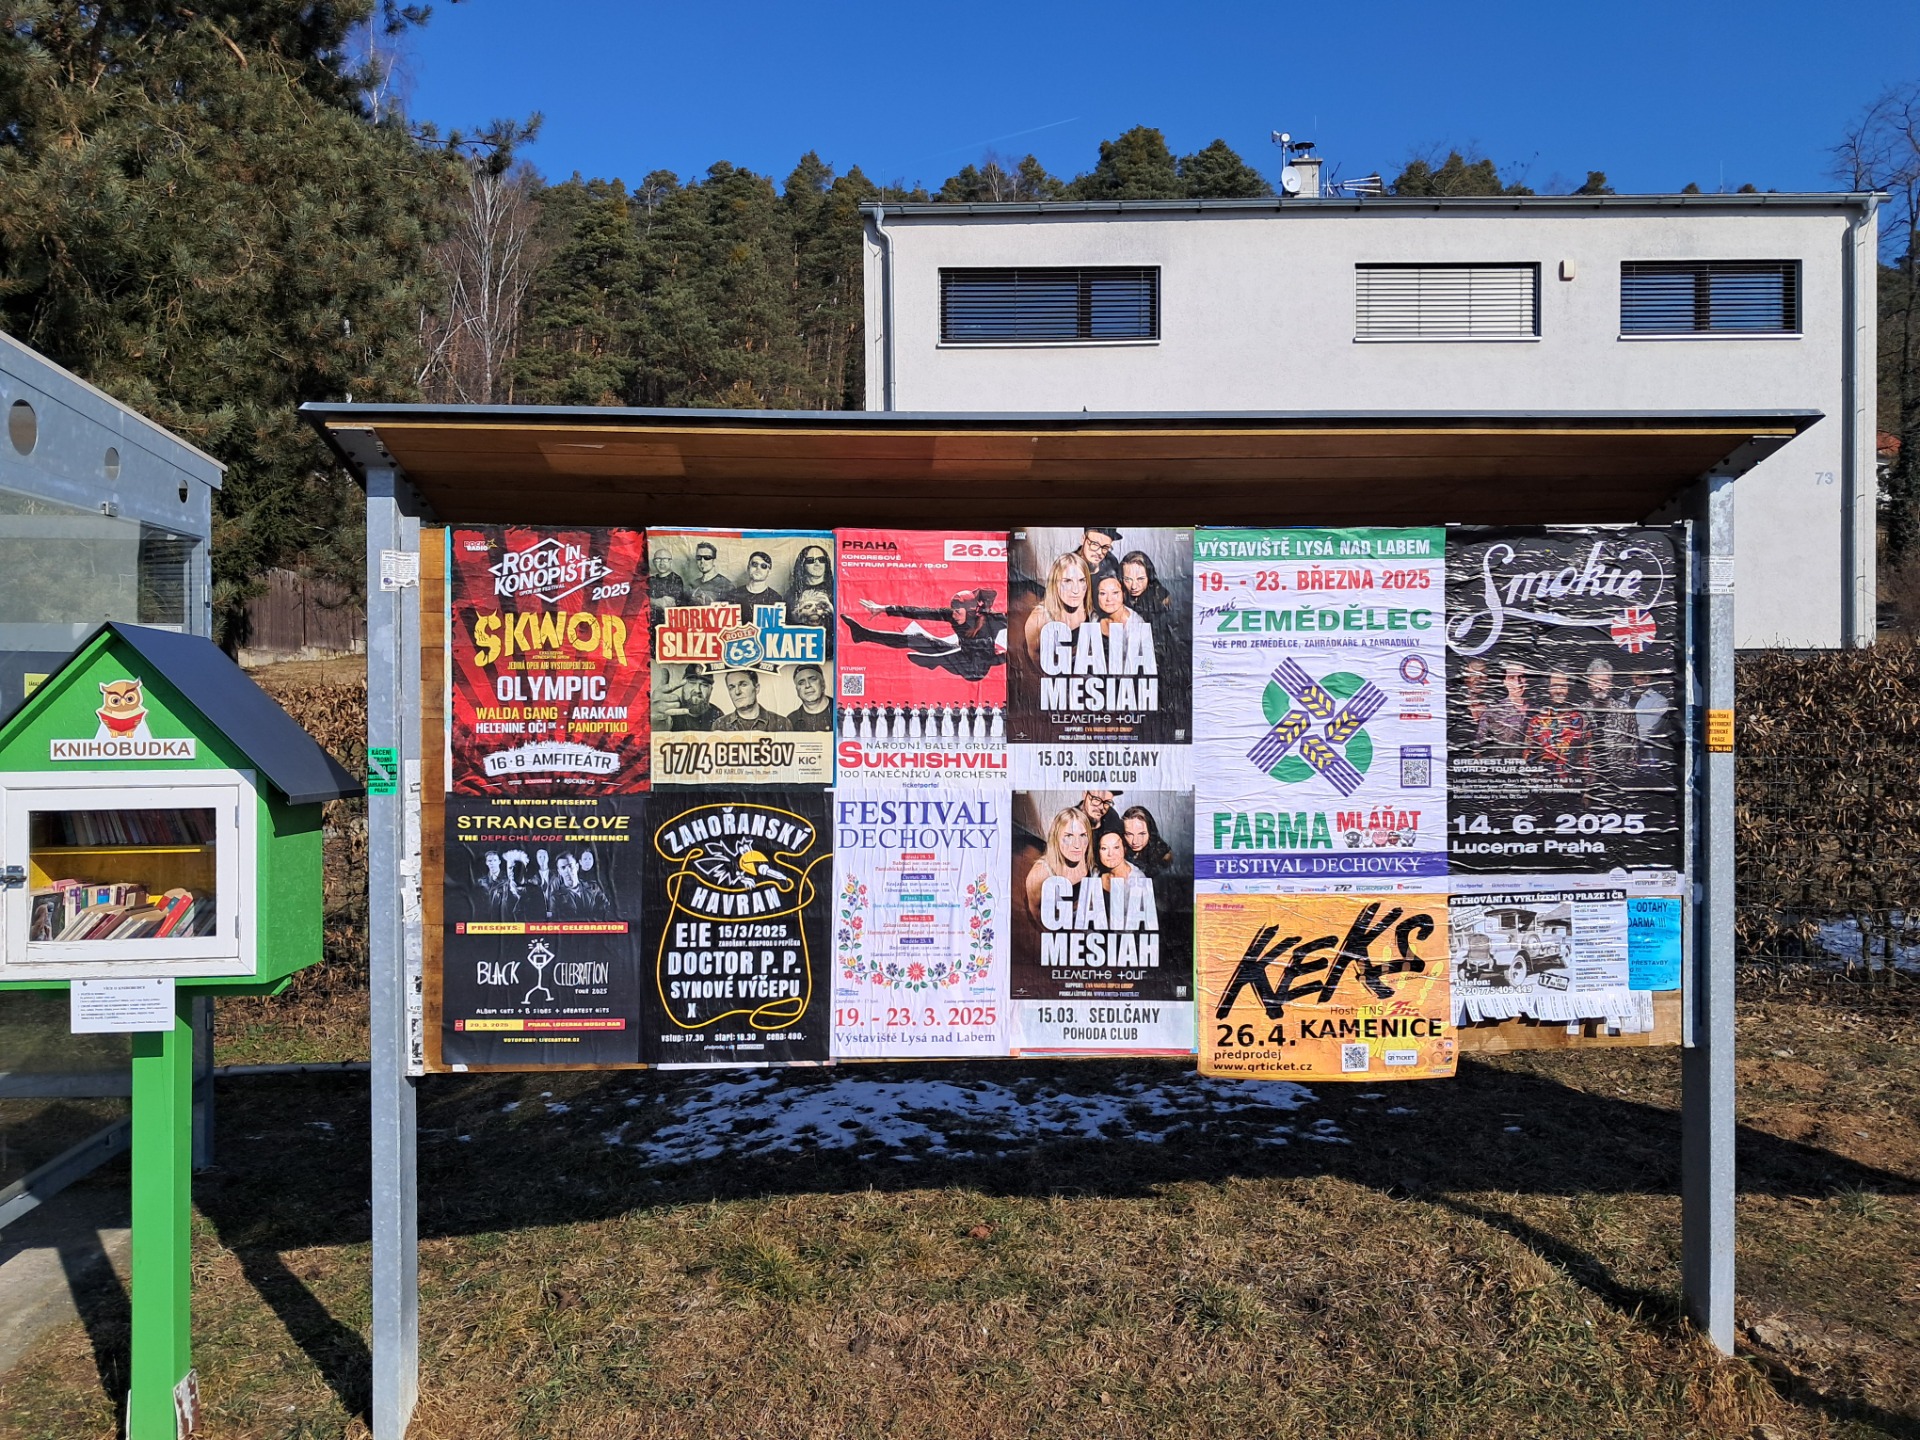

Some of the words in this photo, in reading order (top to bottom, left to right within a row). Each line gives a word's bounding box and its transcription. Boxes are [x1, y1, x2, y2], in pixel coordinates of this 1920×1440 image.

[1815, 472, 1834, 485] 73
[842, 541, 897, 550] PRAHA
[1199, 537, 1290, 556] VÝSTAVIŠTĚ
[1297, 537, 1333, 556] LYSÁ
[1340, 540, 1371, 555] NAD
[1377, 539, 1429, 555] LABEM
[502, 549, 560, 576] ROCK
[1199, 572, 1229, 592] 19.
[1256, 571, 1287, 591] 23.
[1297, 565, 1374, 590] BŘEZNA
[1382, 569, 1431, 589] 2025
[592, 582, 631, 600] 2025
[1446, 541, 1664, 655] Smokie
[668, 604, 741, 628] HORKÝŽE
[757, 604, 784, 628] INÉ
[1199, 597, 1236, 625] jarní
[1217, 604, 1432, 632] ZEMĚDĚLEC
[662, 628, 718, 658] SLÍŽE
[766, 633, 818, 659] KAFE
[730, 640, 756, 661] 63
[1040, 621, 1158, 675] GAIA
[1212, 638, 1228, 648] VŠE
[1231, 640, 1247, 648] PRO
[1251, 638, 1301, 649] ZEMĚDĚLCE,
[1305, 637, 1358, 647] ZAHRÁDKÁŘE
[1370, 638, 1420, 647] ZAHRADNÍKY
[497, 676, 606, 701] OLYMPIC
[1040, 677, 1158, 711] MESIAH
[476, 707, 520, 720] WALDA
[524, 707, 558, 720] GANG
[572, 706, 628, 719] ARAKAIN
[528, 720, 546, 733] OČI
[568, 722, 628, 733] PANOPTIKO
[53, 741, 191, 757] KNIHOBUDKA
[866, 742, 920, 750] NÁRODNÍ
[532, 752, 612, 769] AMFITEÁTR
[660, 743, 713, 774] 17/4
[716, 738, 794, 766] BENEŠOV
[1038, 751, 1077, 766] 15.03.
[1089, 747, 1159, 766] SEDLČANY
[864, 769, 930, 778] TANEČNÍKŮ
[1063, 770, 1106, 782] POHODA
[1110, 770, 1137, 782] CLUB
[457, 815, 630, 830] STRANGELOVE
[838, 801, 998, 825] FESTIVAL
[664, 807, 812, 854] ZAHOŘANSKÝ
[1213, 812, 1333, 849] FARMA
[1336, 806, 1421, 832] MLÁĎAT
[1453, 815, 1500, 834] 14.
[1512, 815, 1544, 834] 6.
[1555, 813, 1647, 834] 2025
[838, 829, 997, 848] DECHOVKY
[1453, 840, 1537, 854] Lucerna
[1544, 840, 1605, 854] Praha
[1215, 858, 1306, 874] FESTIVAL
[1313, 856, 1422, 873] DECHOVKY
[691, 887, 782, 915] HAVRAN
[1041, 876, 1159, 931] GAIA
[1451, 895, 1504, 905] STĚHOVÁNÍ
[1513, 893, 1560, 902] VYKLÍZENÍ
[1575, 892, 1605, 900] PRAZE
[1611, 891, 1624, 899] ČR
[1636, 902, 1668, 912] ODTAHY
[676, 923, 711, 947] E!E
[718, 924, 787, 938] 15/3/2025
[1041, 933, 1160, 967] MESIAH
[668, 951, 753, 975] DOCTOR
[1216, 902, 1434, 1020] KEKS
[477, 961, 520, 985] BLACK
[553, 961, 609, 986] CELEBRATION
[1540, 975, 1551, 985] 17
[670, 975, 733, 998] SYNOVÉ
[738, 975, 800, 998] VÝČEPU
[1455, 987, 1478, 995] +420
[687, 1003, 696, 1018] X
[835, 1008, 864, 1026] 19.
[887, 1008, 916, 1026] 23.
[923, 1008, 940, 1026] 3.
[948, 1007, 996, 1026] 2025
[1038, 1008, 1077, 1023] 15.03.
[1089, 1004, 1160, 1023] SEDLČANY
[1331, 1006, 1358, 1015] Host:
[1362, 1006, 1384, 1015] TNS
[661, 1034, 684, 1042] vstup:
[836, 1032, 897, 1045] Výstaviště
[901, 1032, 927, 1046] Lysá
[931, 1032, 951, 1042] nad
[957, 1032, 995, 1042] Labem
[1063, 1028, 1107, 1040] POHODA
[1111, 1027, 1137, 1040] CLUB
[1217, 1024, 1296, 1047] 26.4.
[1301, 1018, 1442, 1038] KAMENICE
[1214, 1050, 1281, 1061] předprodej
[1214, 1062, 1312, 1072] www.qrticket.cz
